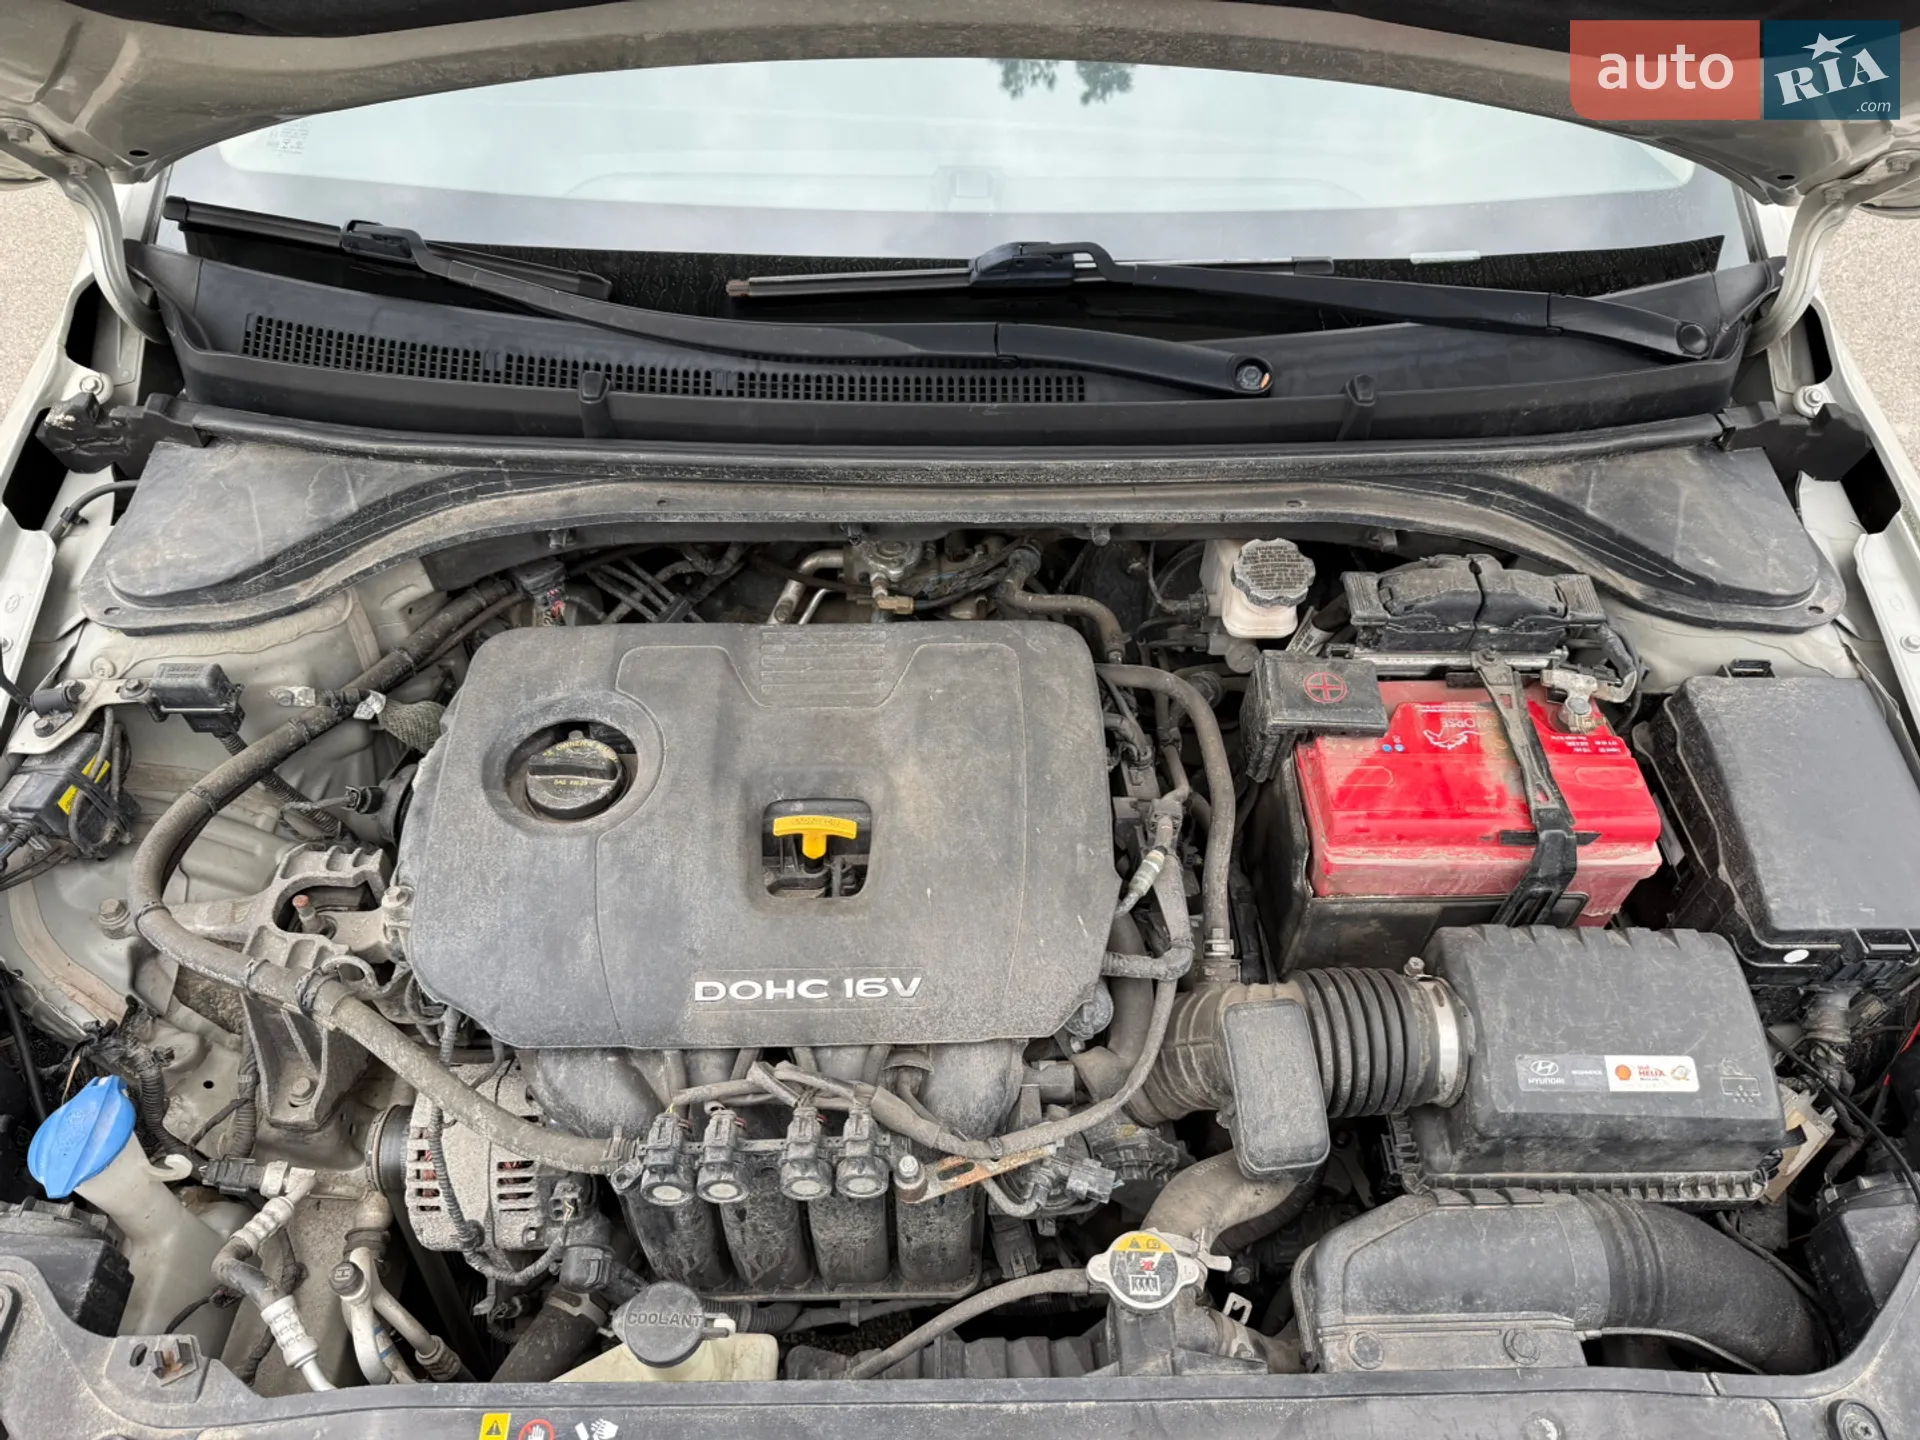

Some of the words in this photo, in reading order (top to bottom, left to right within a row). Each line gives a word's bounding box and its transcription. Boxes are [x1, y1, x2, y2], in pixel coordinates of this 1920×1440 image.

[695, 979, 829, 1001] DOHC
[844, 977, 922, 999] 16V
[627, 1312, 703, 1328] COOLANT
